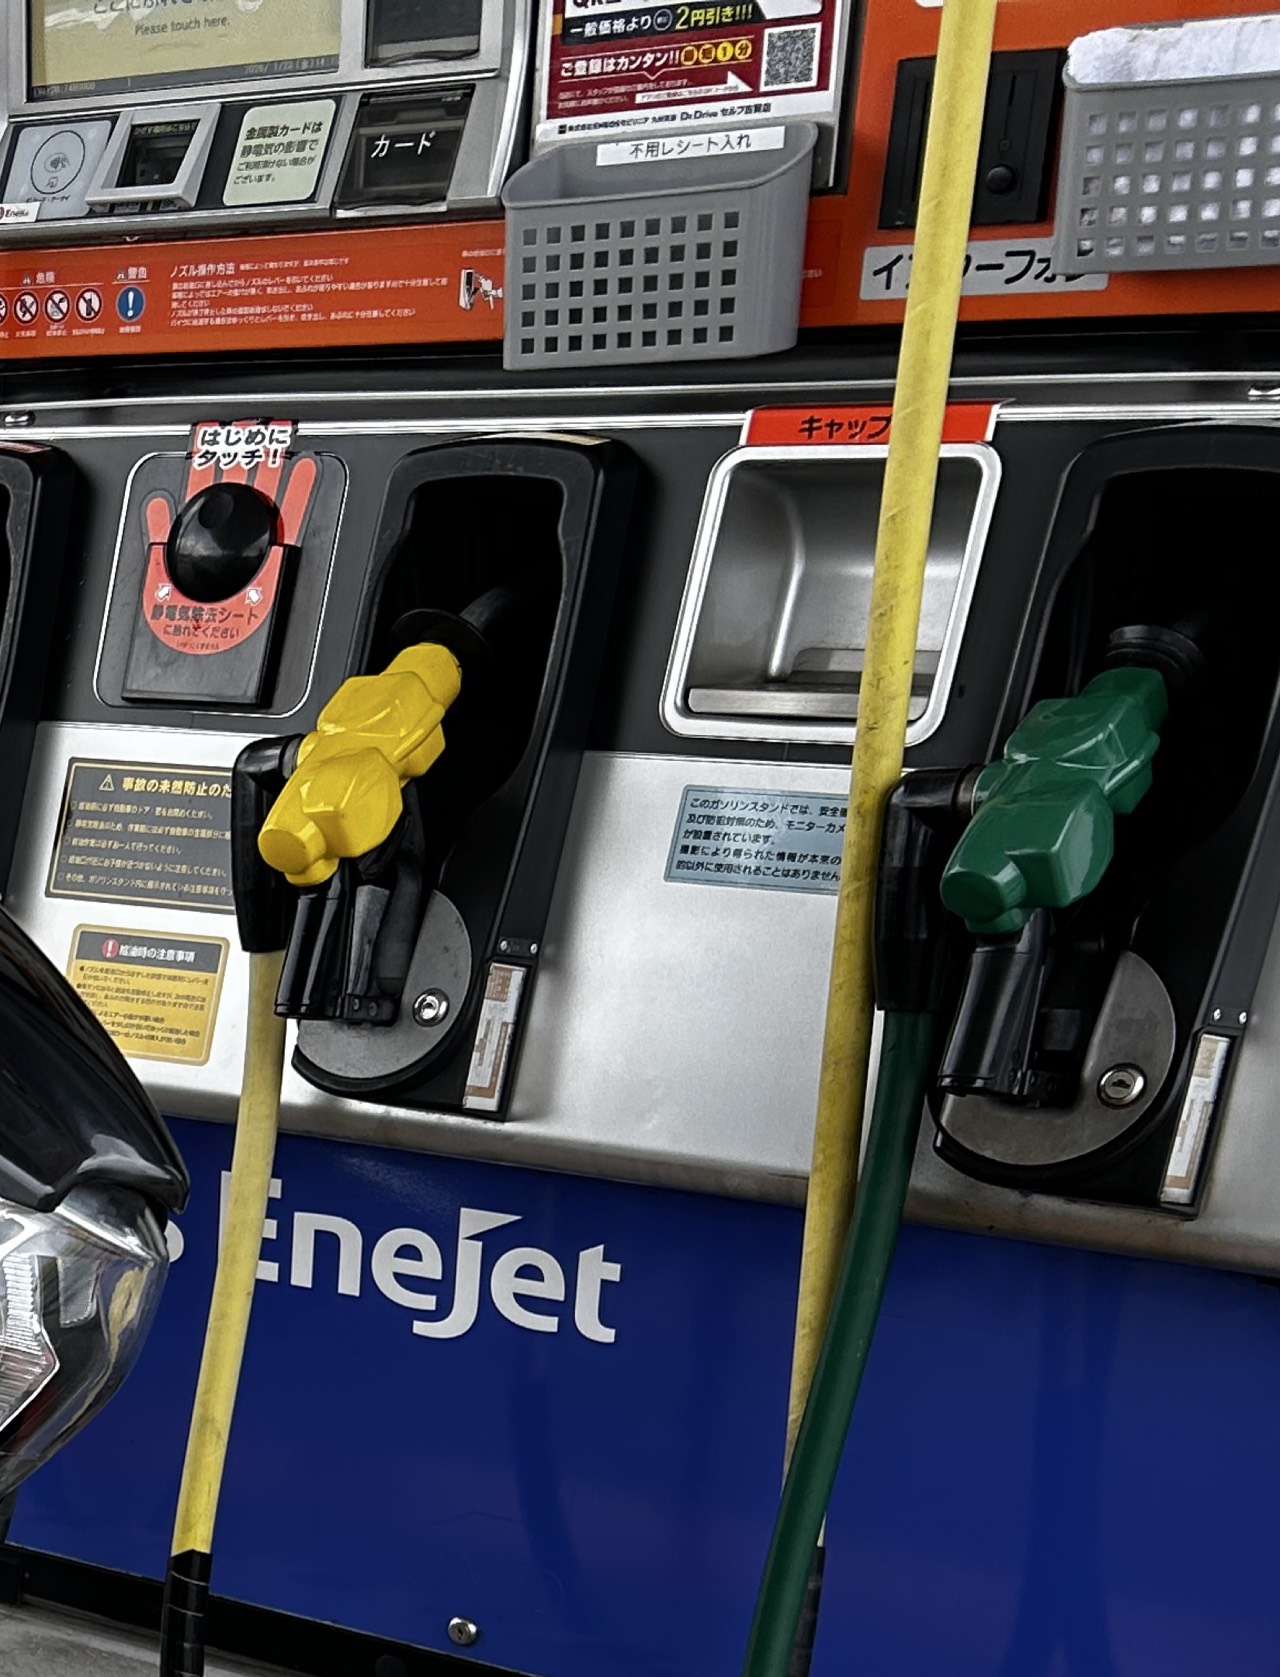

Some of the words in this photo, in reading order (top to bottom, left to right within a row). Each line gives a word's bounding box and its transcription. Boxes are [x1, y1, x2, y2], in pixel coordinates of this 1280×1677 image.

[134, 23, 168, 37] Please
[170, 19, 201, 33] touch
[570, 15, 651, 38] 一般価格より
[371, 132, 436, 159] カード
[630, 134, 751, 159] 不用レシート入れ
[200, 427, 290, 447] はじめに
[197, 448, 281, 468] タッチ!
[151, 605, 258, 626] 静電気除去シート
[683, 829, 776, 845] が設置されています。
